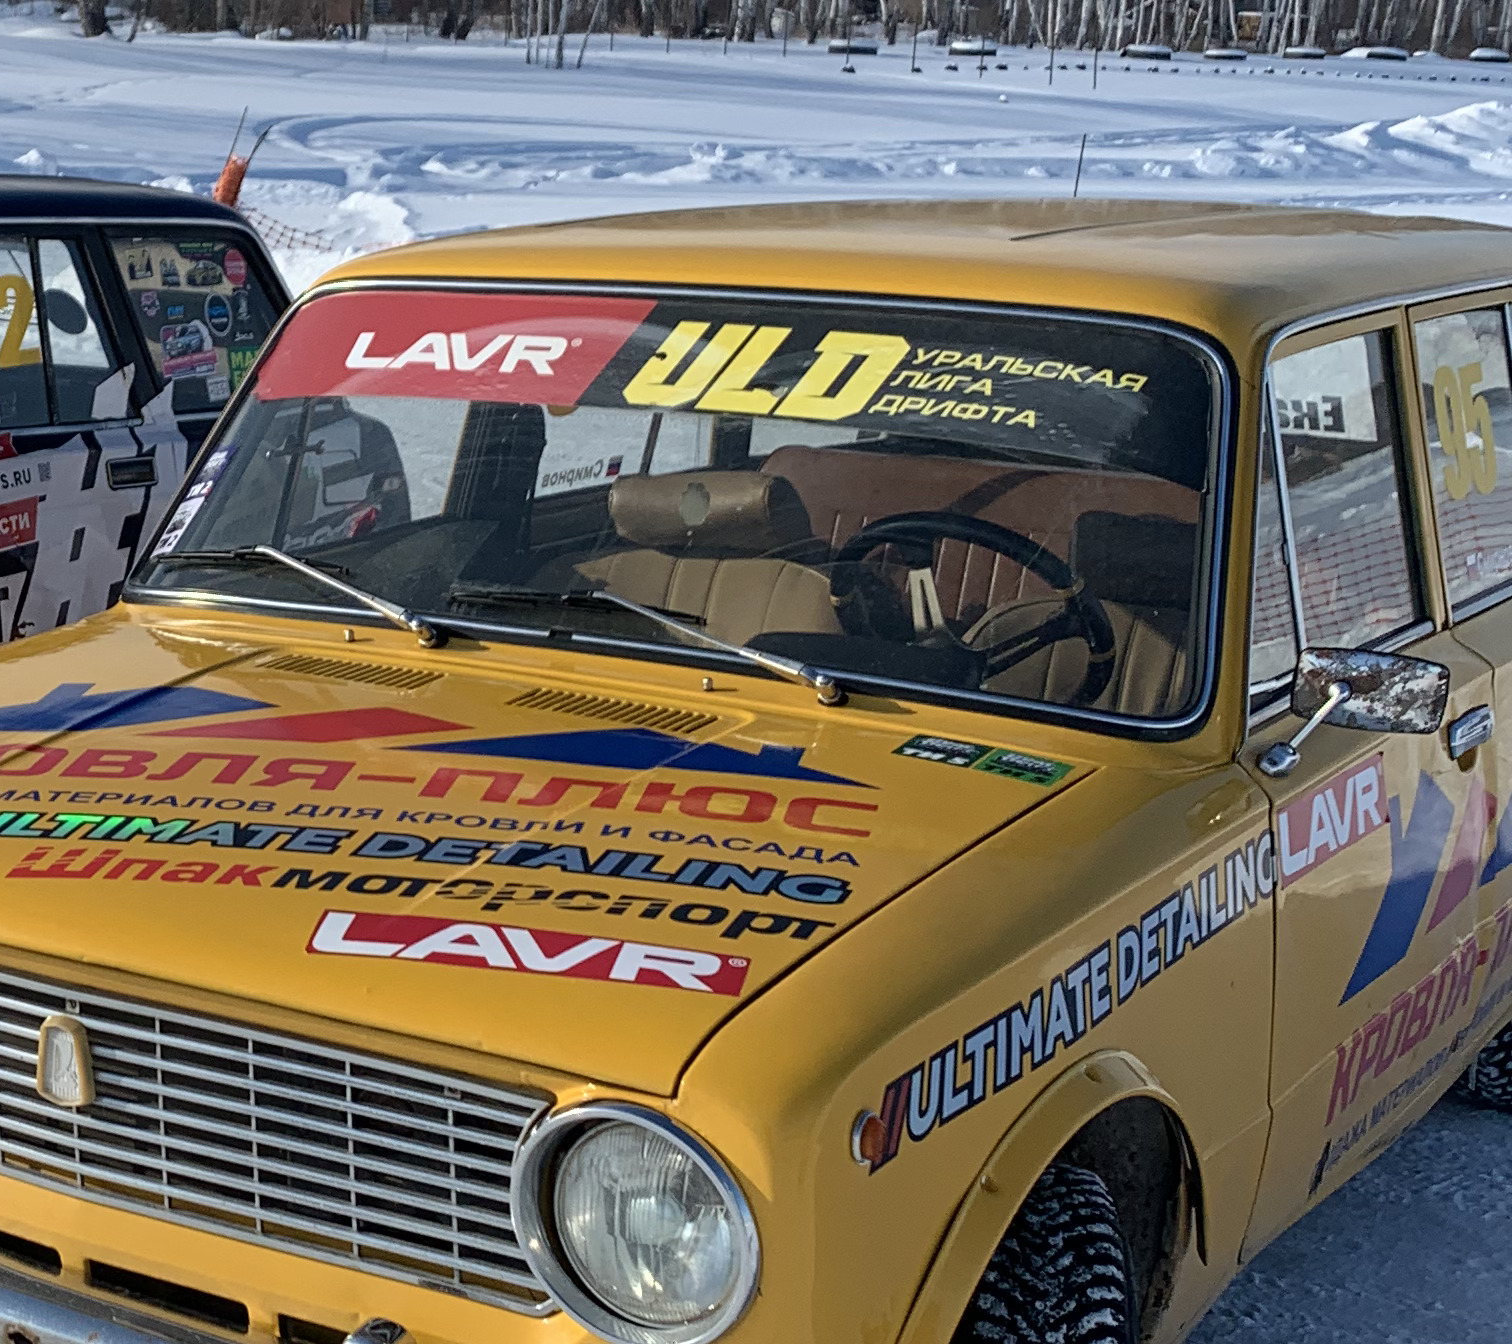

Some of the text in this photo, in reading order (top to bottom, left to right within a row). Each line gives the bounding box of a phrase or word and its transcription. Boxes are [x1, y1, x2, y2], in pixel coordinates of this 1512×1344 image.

[344, 331, 568, 376] LAVR
[621, 320, 912, 422] ULD
[888, 369, 994, 397] ЛИГА
[910, 347, 1149, 393] УРАЛЬСКАЯ
[868, 394, 1038, 429] ДРИФТА
[1433, 361, 1498, 501] 95
[285, 804, 383, 821] ДЛЯ
[396, 809, 585, 834] КРОВЛИ
[600, 824, 631, 839] И
[648, 828, 861, 867] ФАСАДА
[1278, 763, 1381, 878] LAVR
[356, 831, 853, 905] DETAILING
[310, 910, 723, 993] LAVR
[906, 940, 1112, 1142] ULTIMATE
